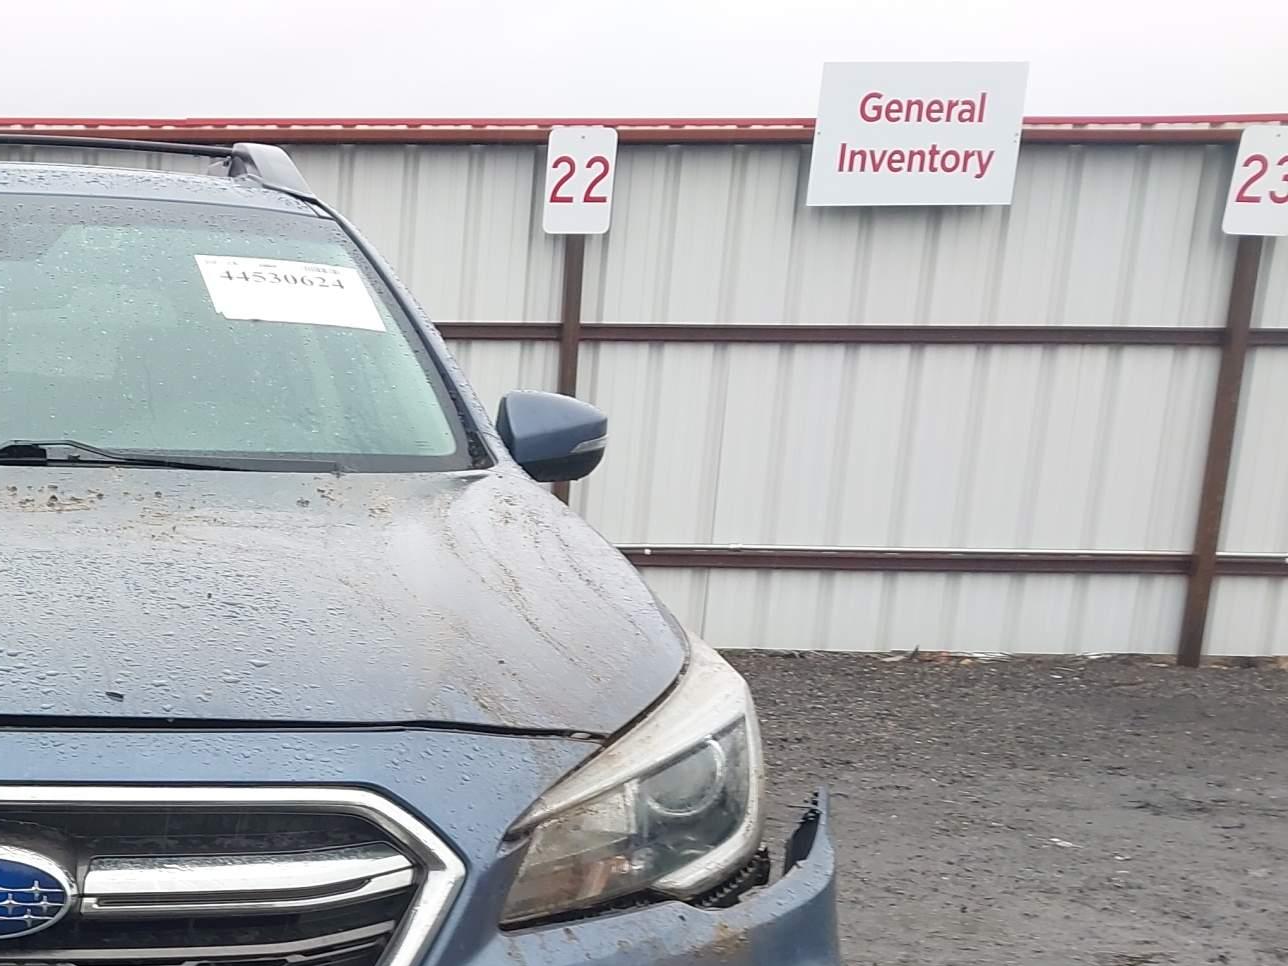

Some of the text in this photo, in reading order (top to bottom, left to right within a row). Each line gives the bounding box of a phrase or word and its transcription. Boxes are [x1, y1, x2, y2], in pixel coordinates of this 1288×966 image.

[859, 92, 987, 124] General
[837, 142, 995, 179] Inventory
[549, 155, 610, 203] 22
[219, 269, 345, 290] 44530624
